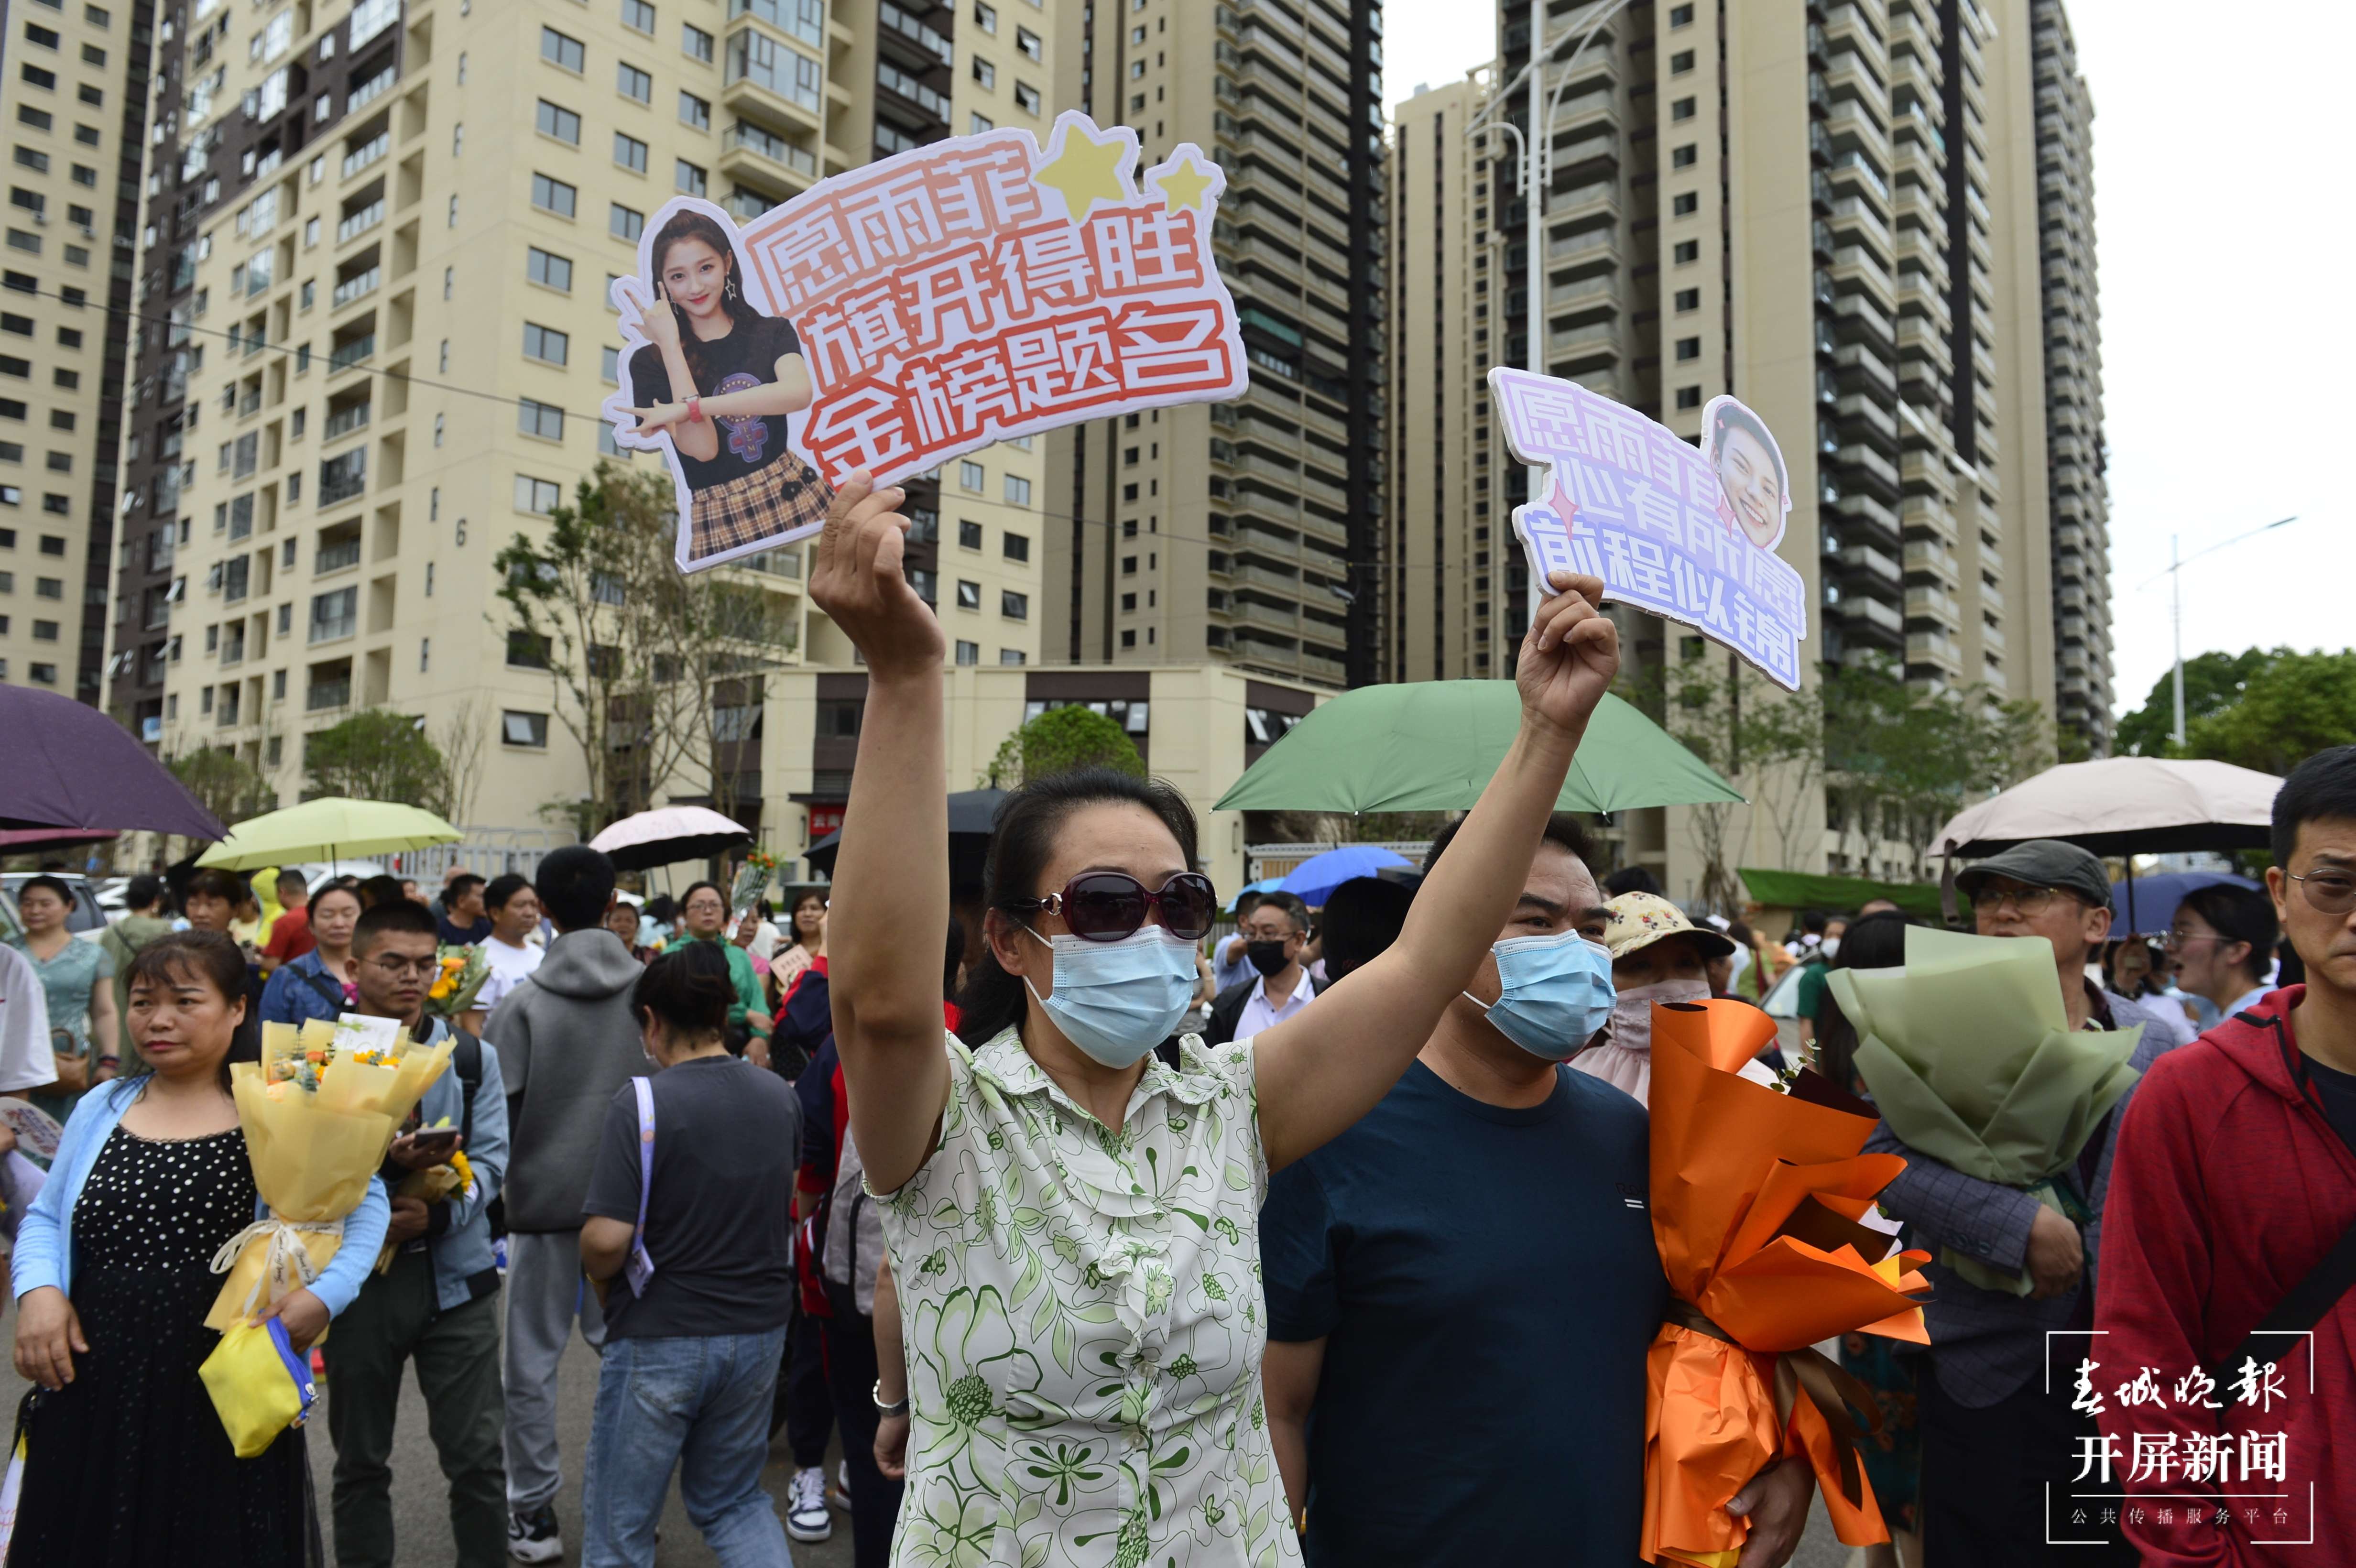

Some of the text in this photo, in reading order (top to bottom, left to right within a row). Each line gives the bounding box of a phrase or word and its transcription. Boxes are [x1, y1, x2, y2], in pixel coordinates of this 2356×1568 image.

[752, 149, 1034, 316] 愿雨菲
[806, 210, 1195, 383] 旗开得胜
[811, 308, 1226, 484] 金榜题名
[1506, 382, 1722, 506] 愿雨菲
[455, 519, 466, 546] 6
[1531, 518, 1791, 671] 前程似锦
[1560, 457, 1799, 626] 心有所愿
